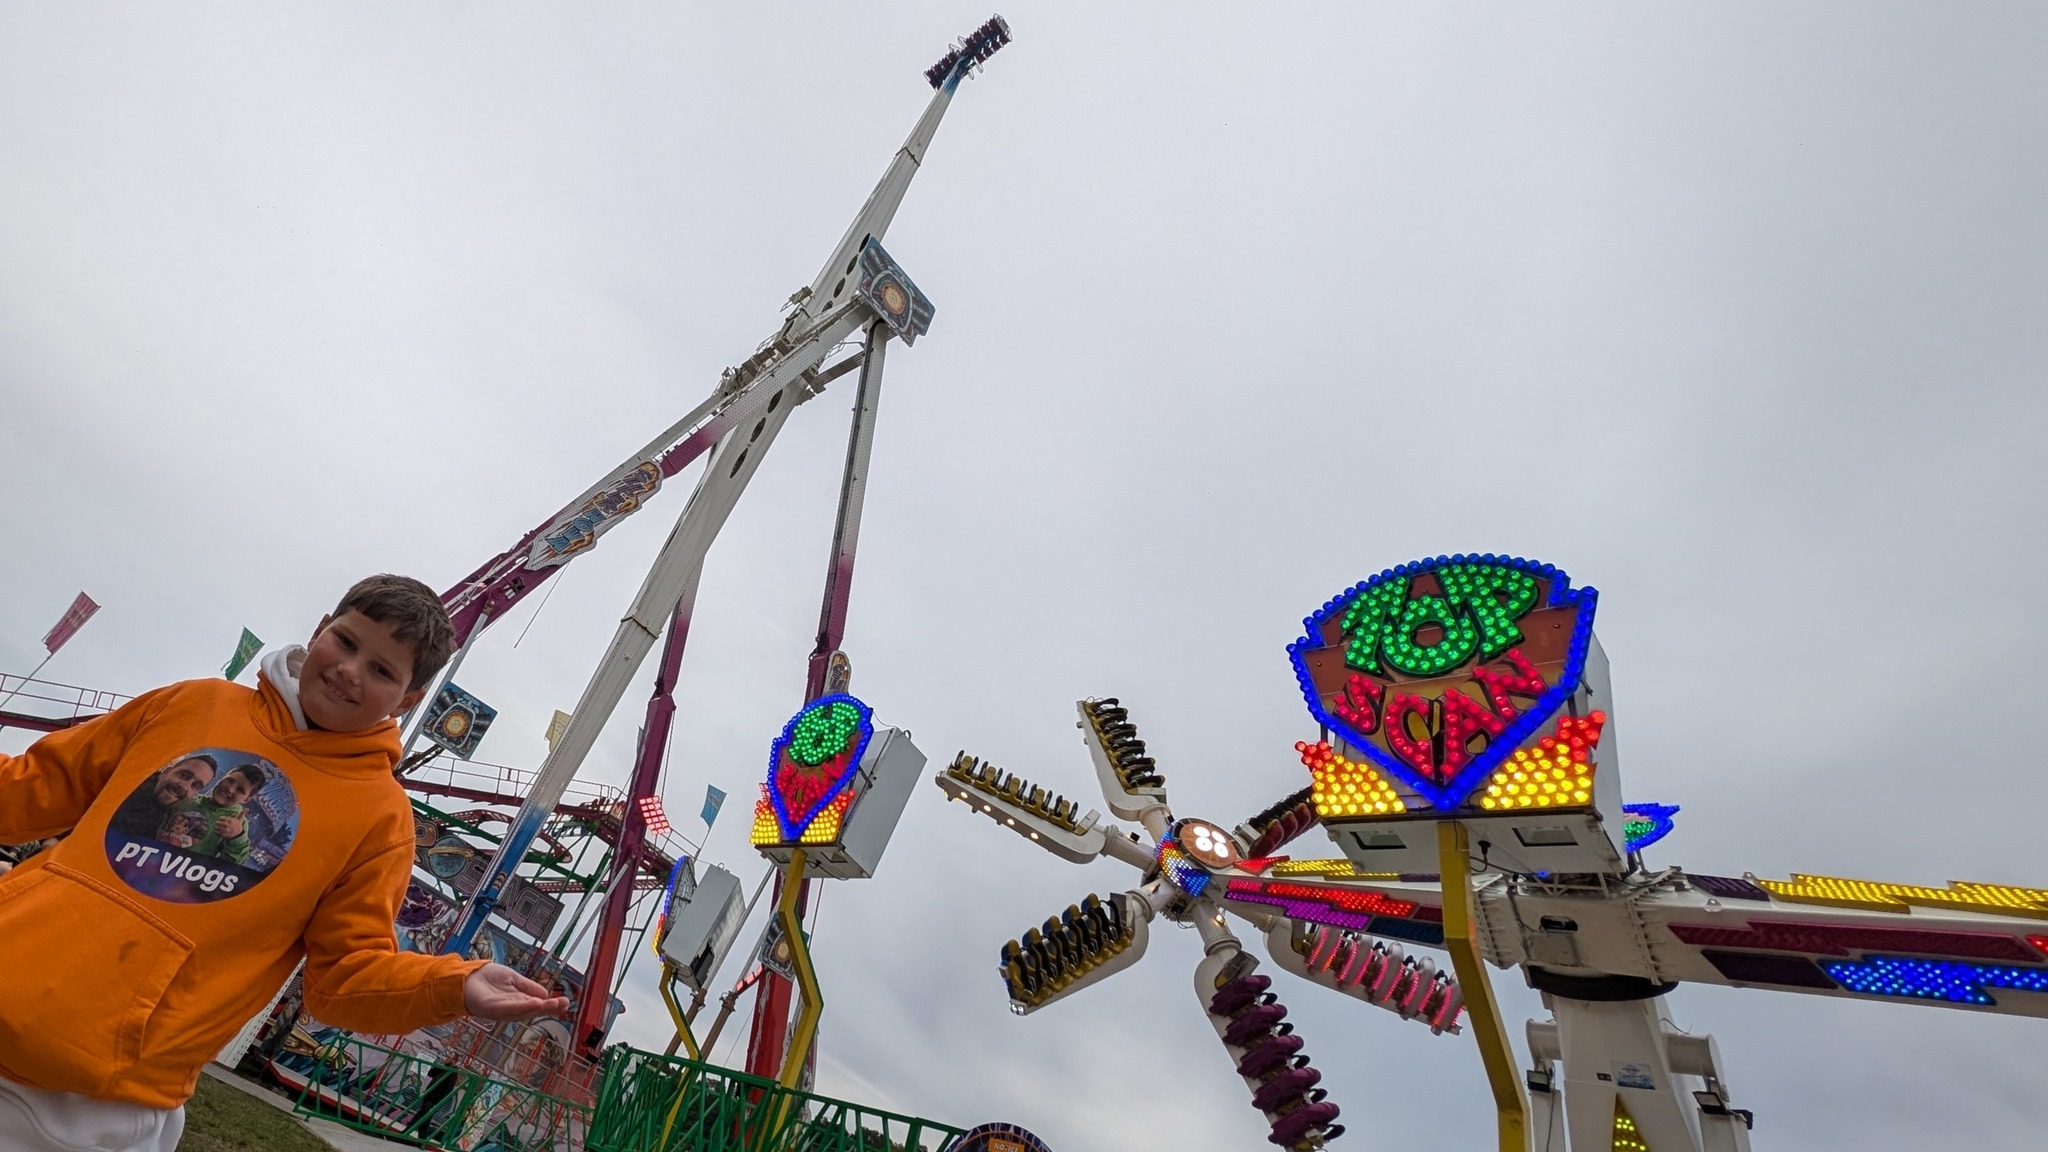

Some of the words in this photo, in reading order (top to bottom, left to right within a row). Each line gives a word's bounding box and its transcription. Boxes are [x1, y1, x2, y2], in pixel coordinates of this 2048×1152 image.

[1339, 564, 1539, 676] TOP
[1334, 648, 1547, 785] SCAN
[115, 841, 159, 867] PT
[159, 852, 239, 892] Vlogs
[455, 857, 557, 938] SACE
